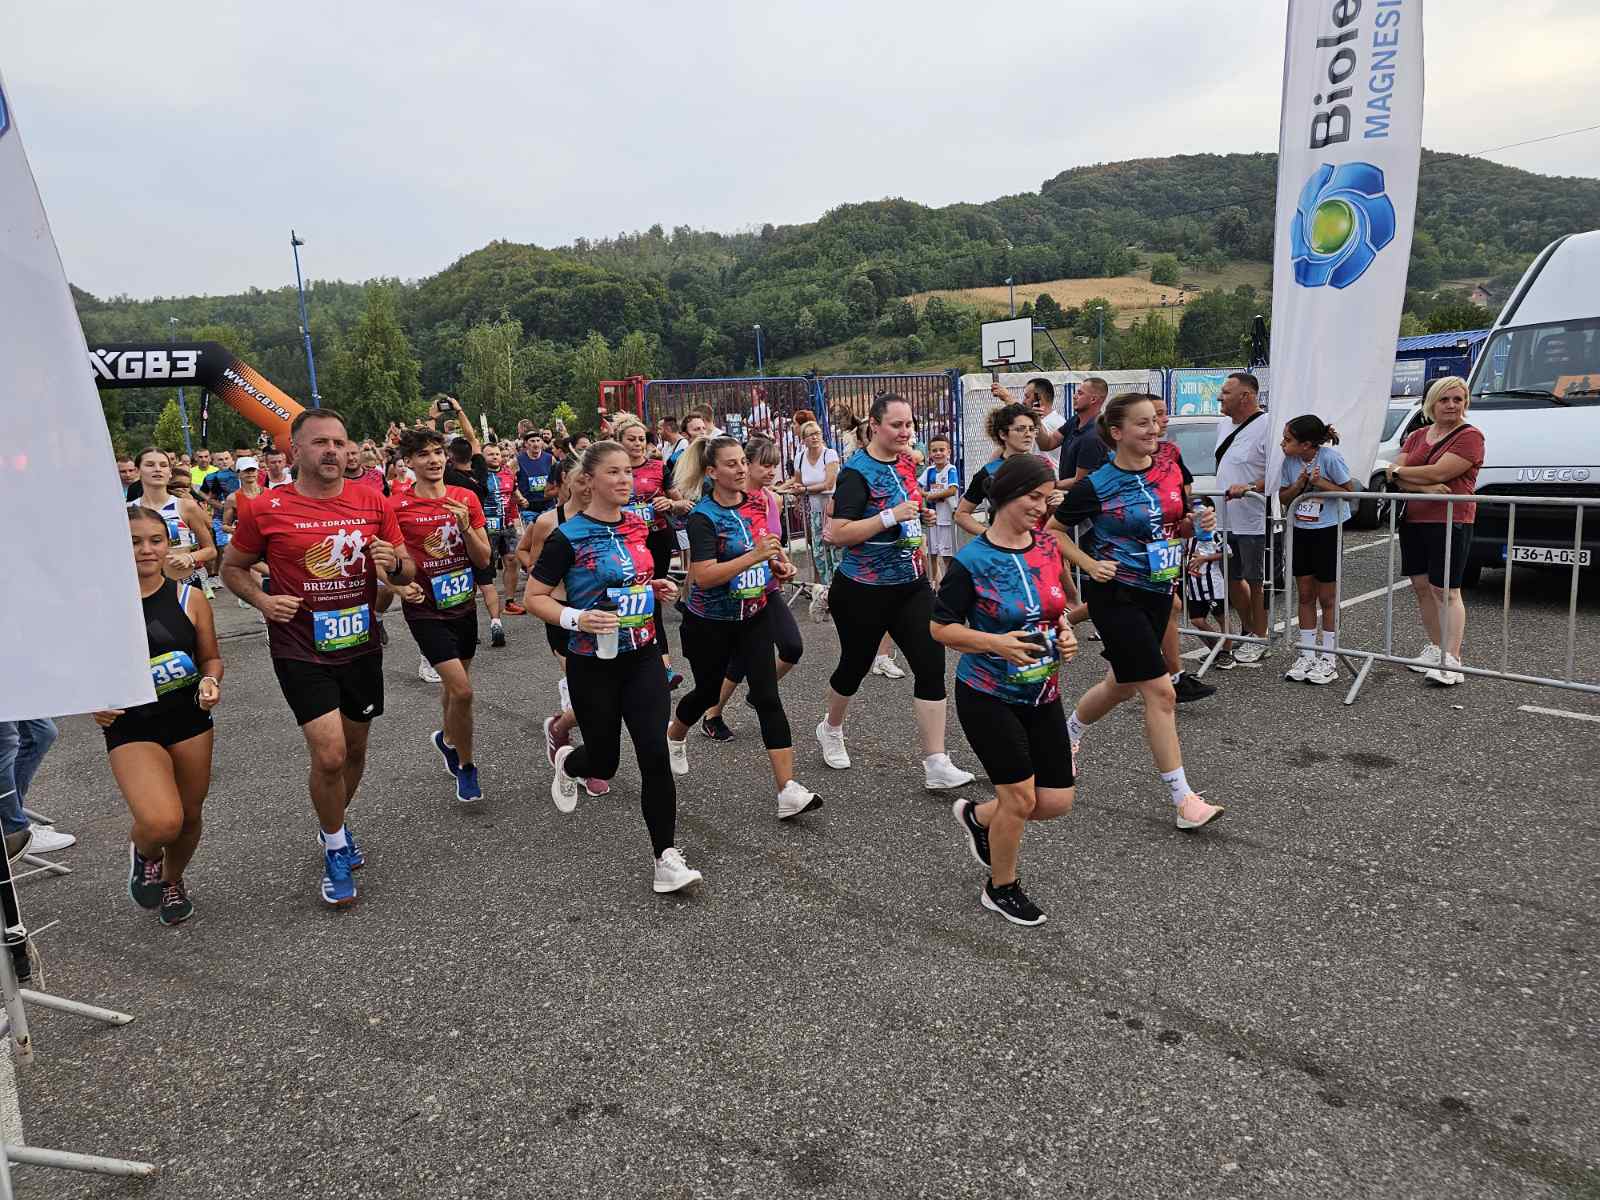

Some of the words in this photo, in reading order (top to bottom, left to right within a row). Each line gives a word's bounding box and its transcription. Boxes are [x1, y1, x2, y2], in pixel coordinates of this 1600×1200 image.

[1516, 469, 1591, 481] IVECO
[294, 521, 319, 529] TRKA
[303, 580, 347, 592] BREZIK
[441, 575, 470, 597] 432
[737, 567, 766, 590] 308
[617, 593, 648, 617] 317
[325, 613, 364, 640] 306
